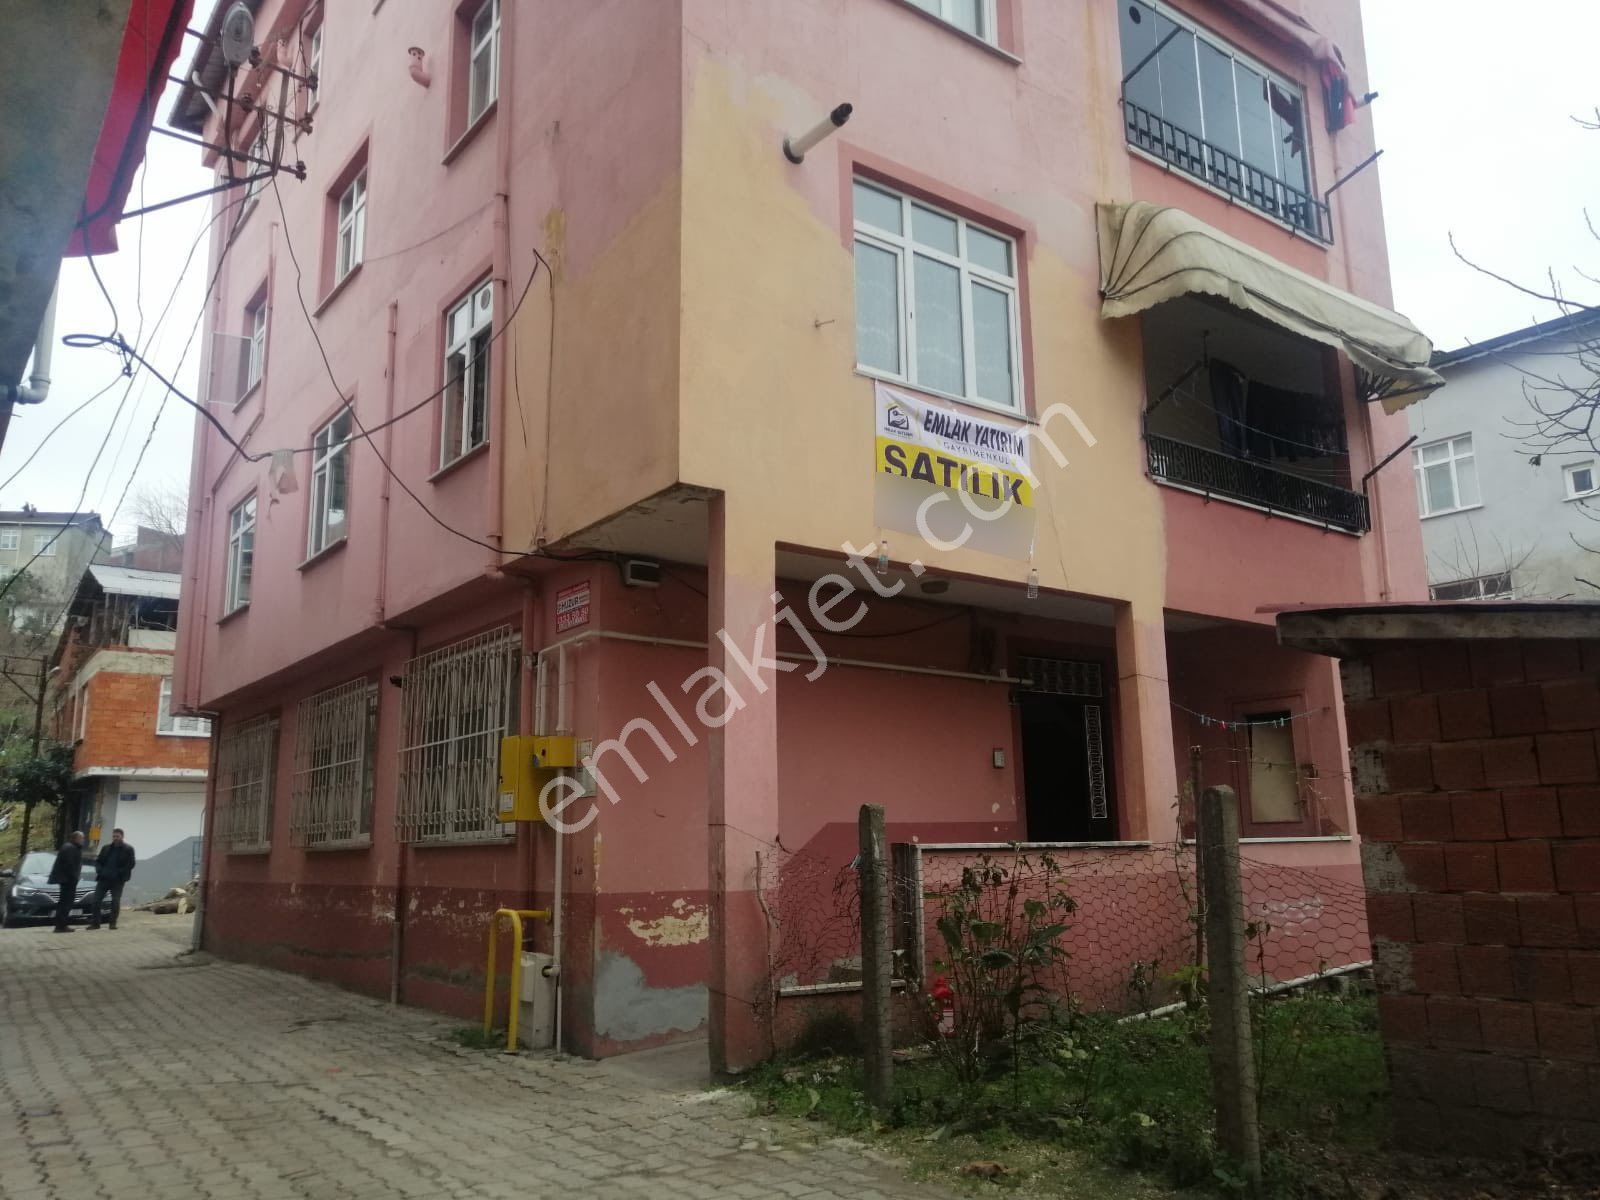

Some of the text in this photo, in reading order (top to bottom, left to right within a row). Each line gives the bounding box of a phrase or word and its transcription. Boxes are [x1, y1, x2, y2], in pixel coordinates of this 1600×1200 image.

[923, 408, 1025, 457] EMLAK YATIRIM
[884, 444, 1023, 506] SATILIK
